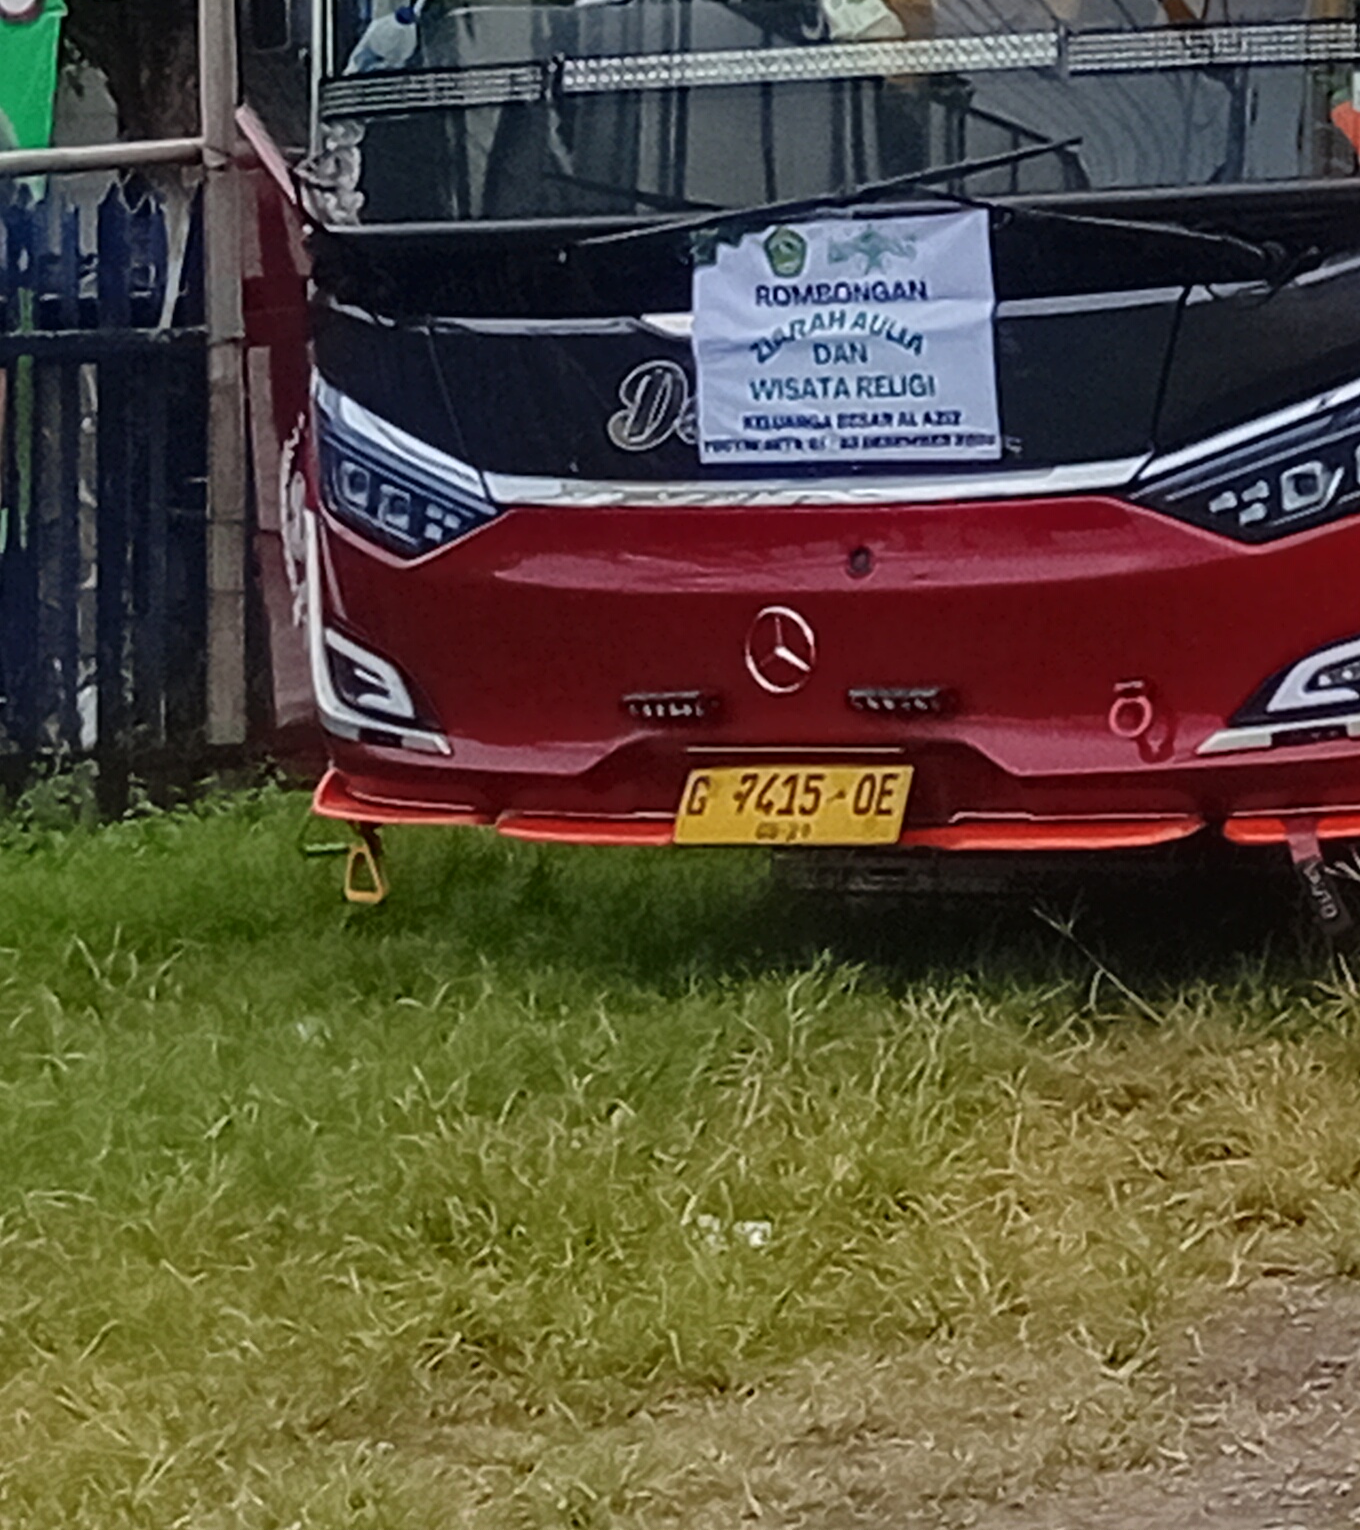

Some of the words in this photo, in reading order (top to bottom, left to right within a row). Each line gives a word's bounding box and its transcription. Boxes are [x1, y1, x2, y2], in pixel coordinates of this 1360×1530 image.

[755, 279, 928, 307] ROMBONGAN
[749, 309, 847, 364] ZIARAH
[851, 310, 924, 356] AULIA
[813, 343, 868, 366] DAN
[749, 376, 851, 402] WISATA
[856, 373, 936, 398] RELIGI
[686, 774, 711, 816] G
[734, 772, 825, 816] 7415
